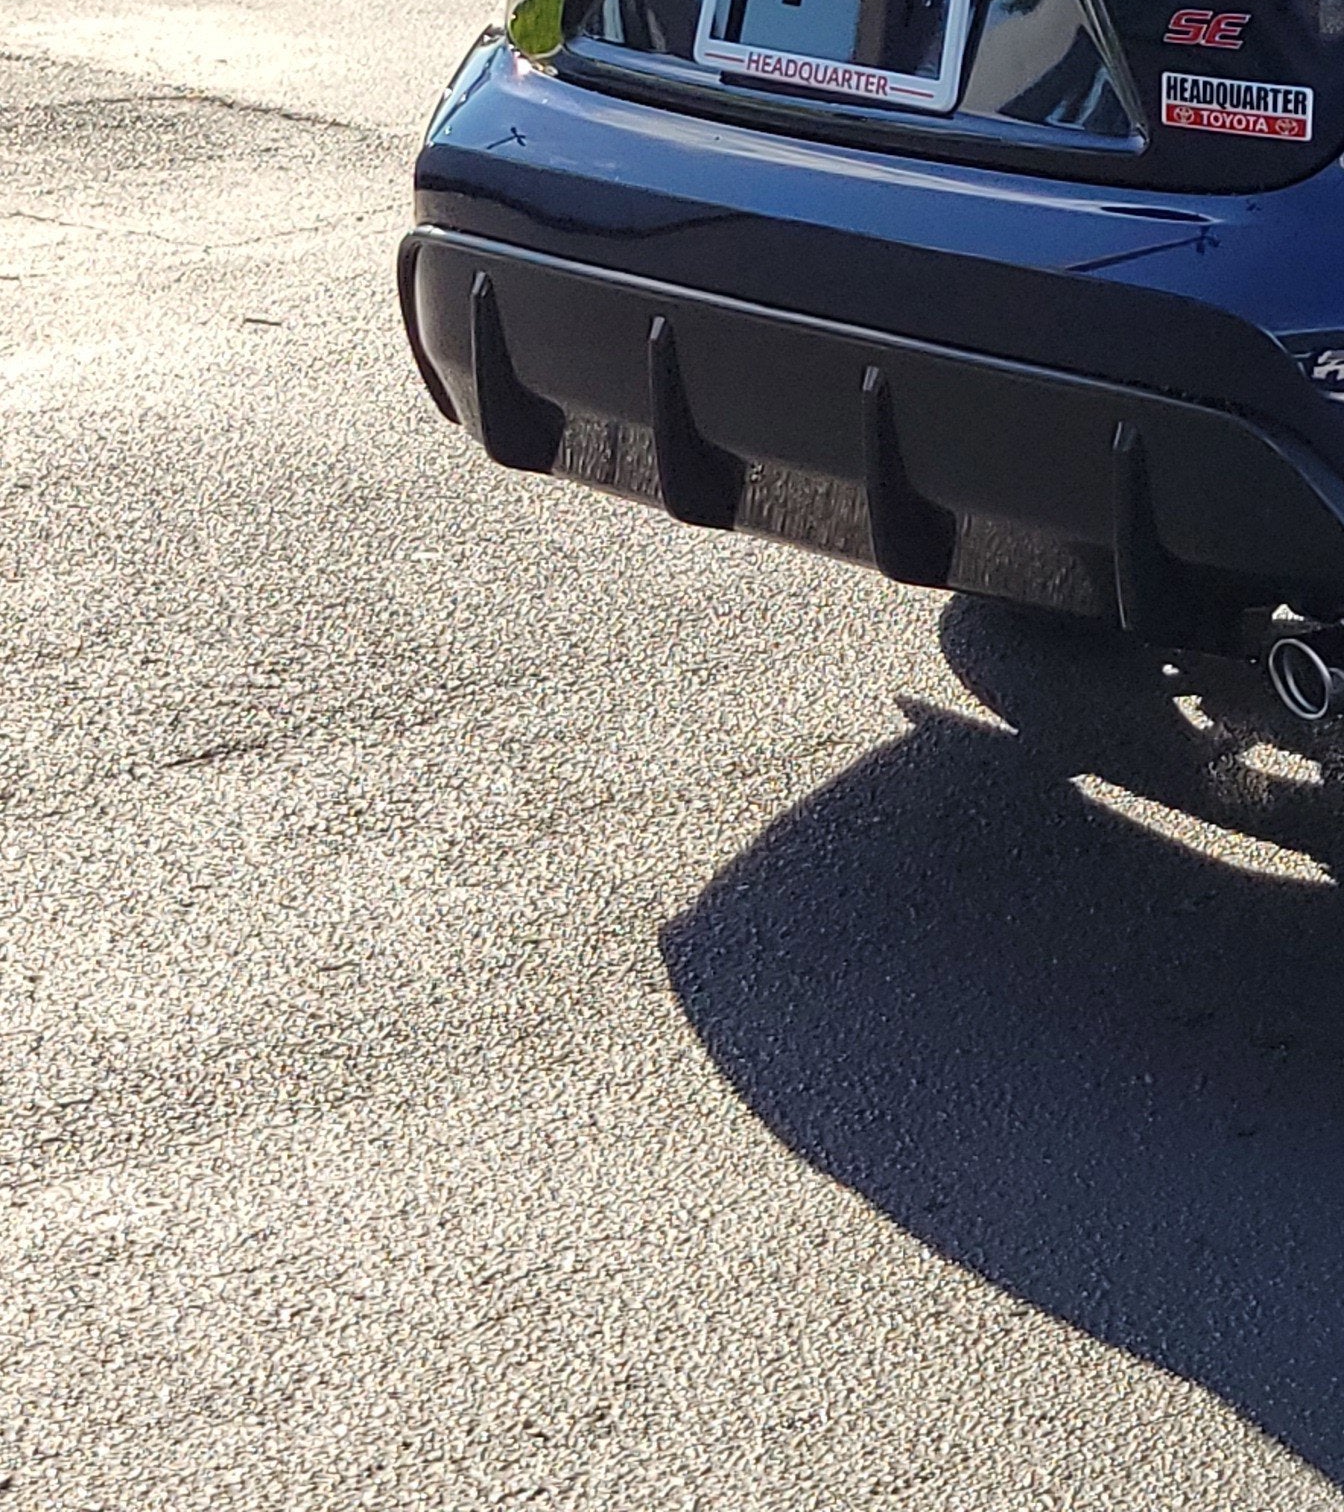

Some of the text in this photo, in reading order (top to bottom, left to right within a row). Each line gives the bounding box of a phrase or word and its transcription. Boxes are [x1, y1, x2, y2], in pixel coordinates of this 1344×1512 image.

[1163, 9, 1251, 49] SE
[746, 51, 888, 96] HEADQUARTER
[1166, 75, 1307, 115] HEADQUARTER
[1200, 110, 1269, 133] TOYOTA
